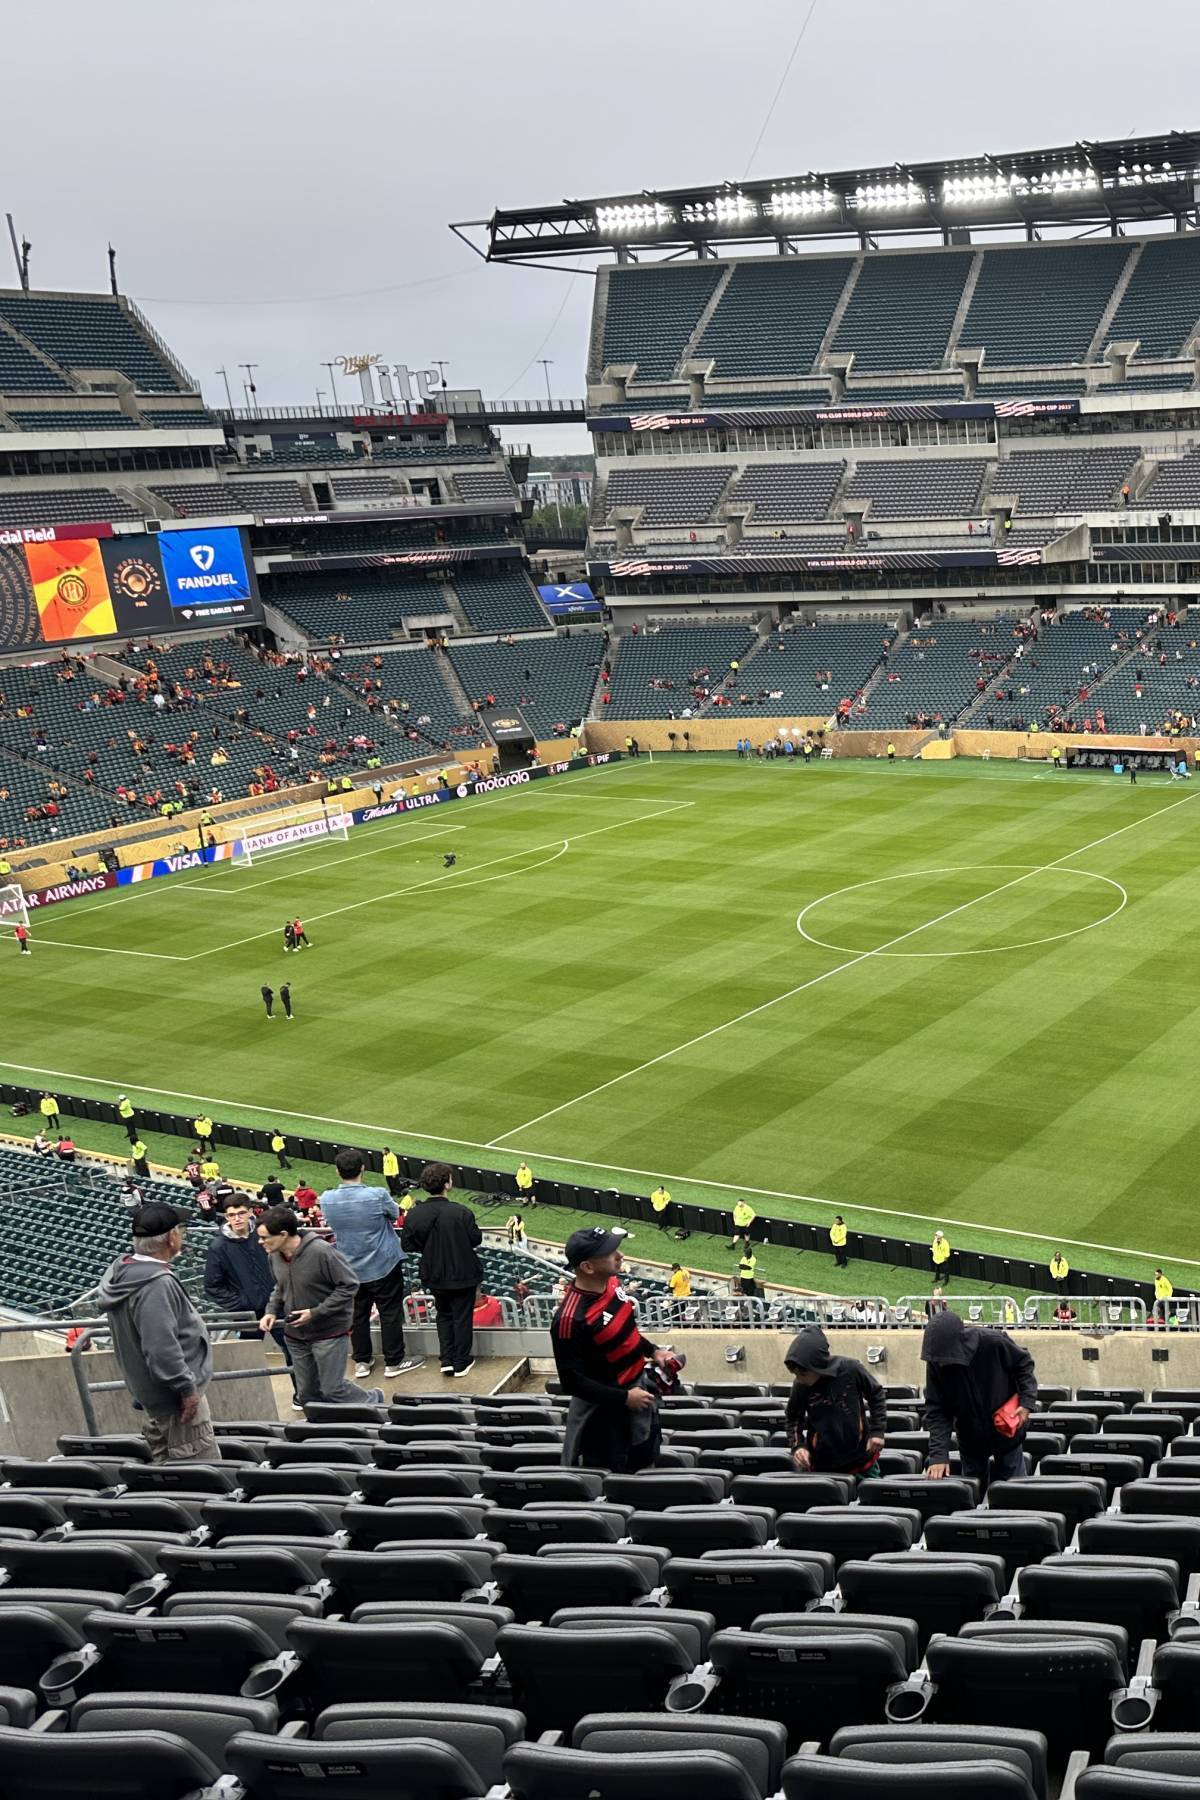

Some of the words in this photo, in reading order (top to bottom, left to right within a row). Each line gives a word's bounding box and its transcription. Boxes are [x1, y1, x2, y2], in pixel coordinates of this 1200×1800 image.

[358, 364, 439, 412] Lite
[23, 527, 56, 542] Field
[176, 572, 238, 590] FANDUEL
[556, 762, 570, 773] PIF
[596, 754, 610, 764] PIF
[474, 770, 530, 794] motorola
[405, 794, 440, 810] ULTRA
[276, 832, 290, 842] OF
[292, 820, 338, 838] AMERIA
[164, 852, 202, 872] VISA
[0, 893, 41, 918] ATAR
[45, 876, 106, 902] AIRWAYS
